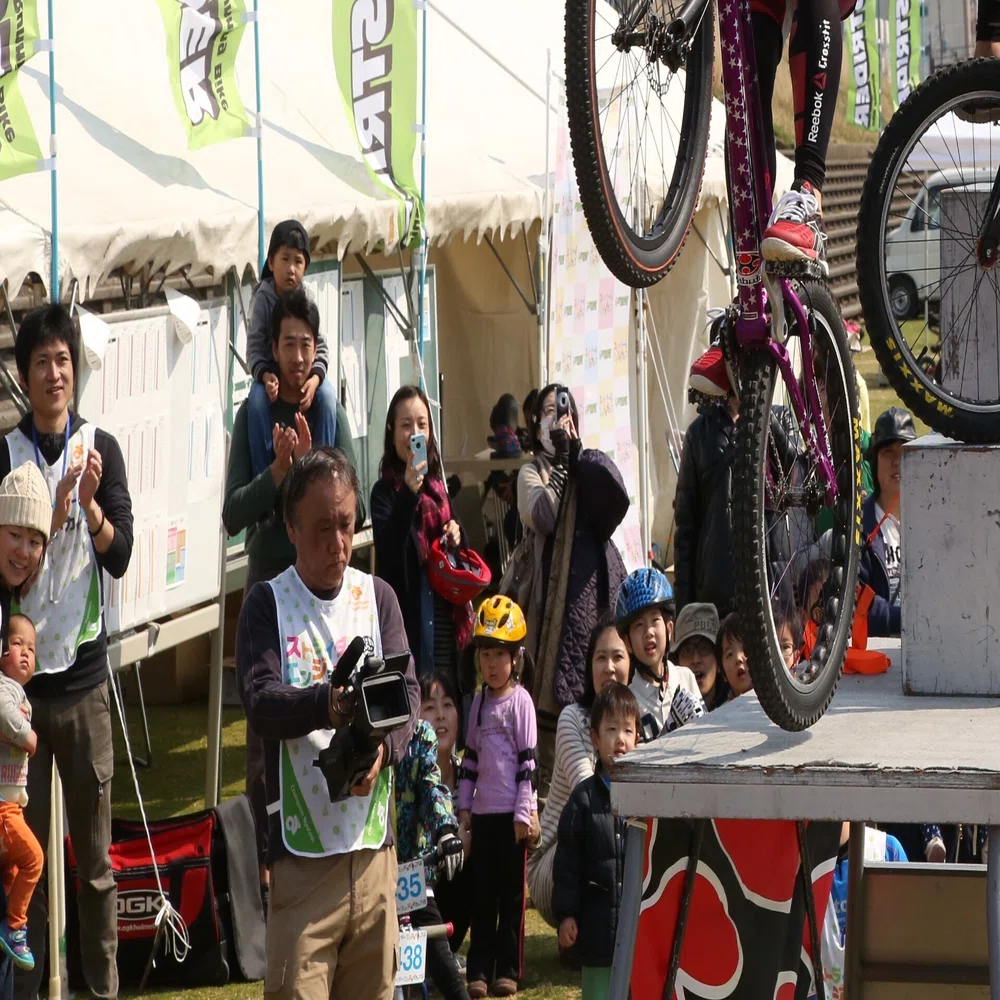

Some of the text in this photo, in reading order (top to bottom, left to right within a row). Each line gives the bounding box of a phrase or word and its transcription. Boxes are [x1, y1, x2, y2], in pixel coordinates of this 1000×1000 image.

[808, 91, 824, 143] Reebok
[886, 337, 953, 417] MAXXIS
[853, 418, 862, 545] MAXXIS
